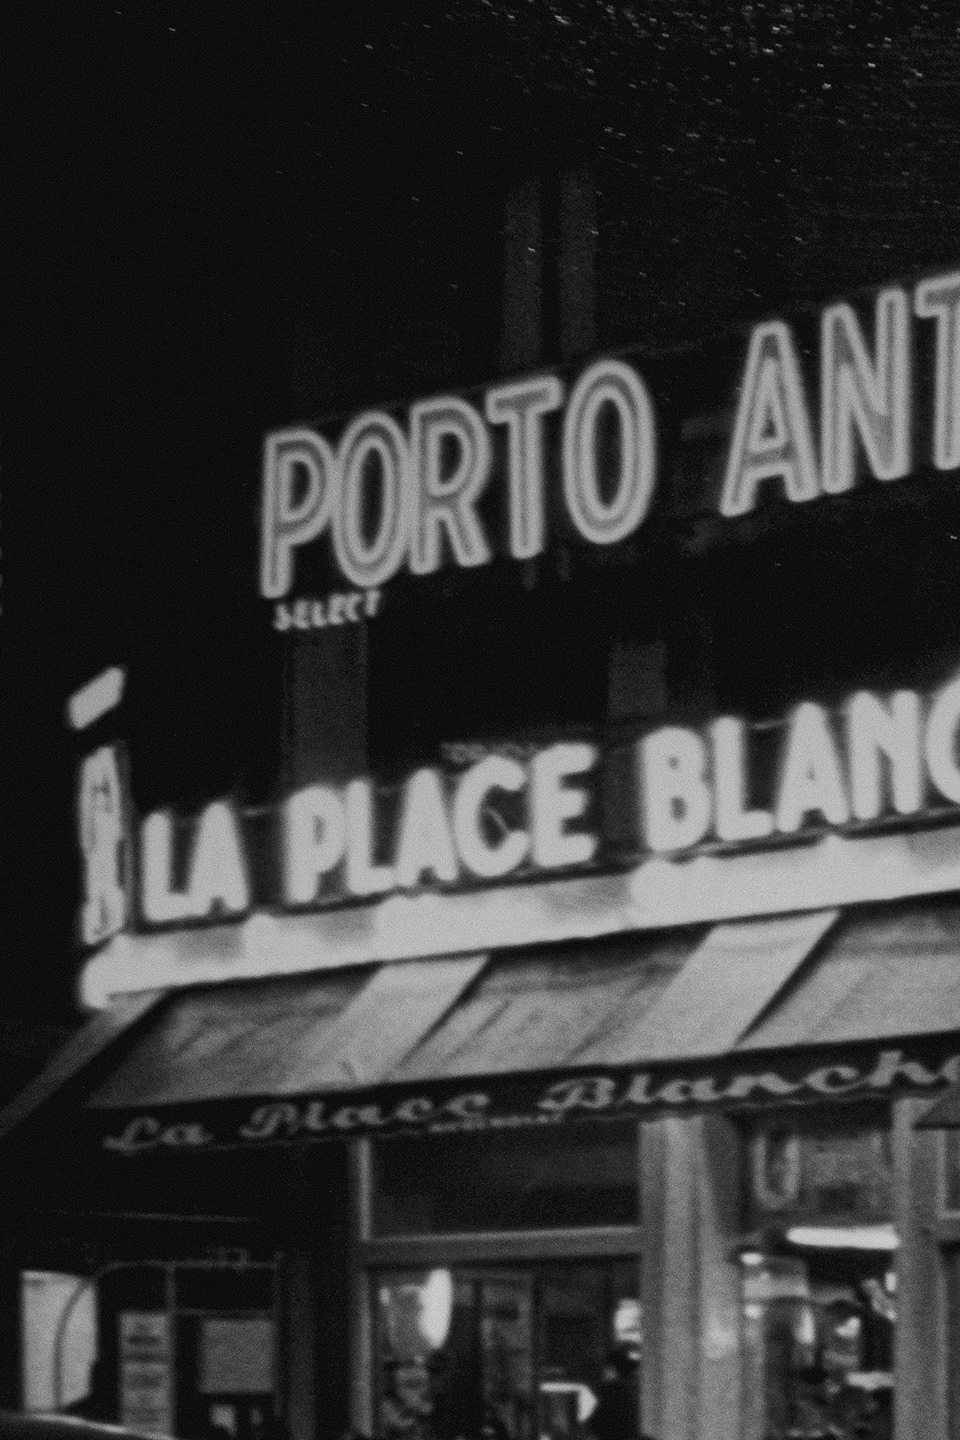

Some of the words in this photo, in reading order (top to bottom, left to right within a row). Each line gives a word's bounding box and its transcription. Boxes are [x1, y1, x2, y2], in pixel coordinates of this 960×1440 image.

[259, 358, 657, 599] PORTO
[273, 590, 382, 631] SELECT
[141, 799, 251, 922] LA
[283, 740, 598, 902] PLACE
[103, 1116, 213, 1155] La
[237, 1091, 491, 1138] Place
